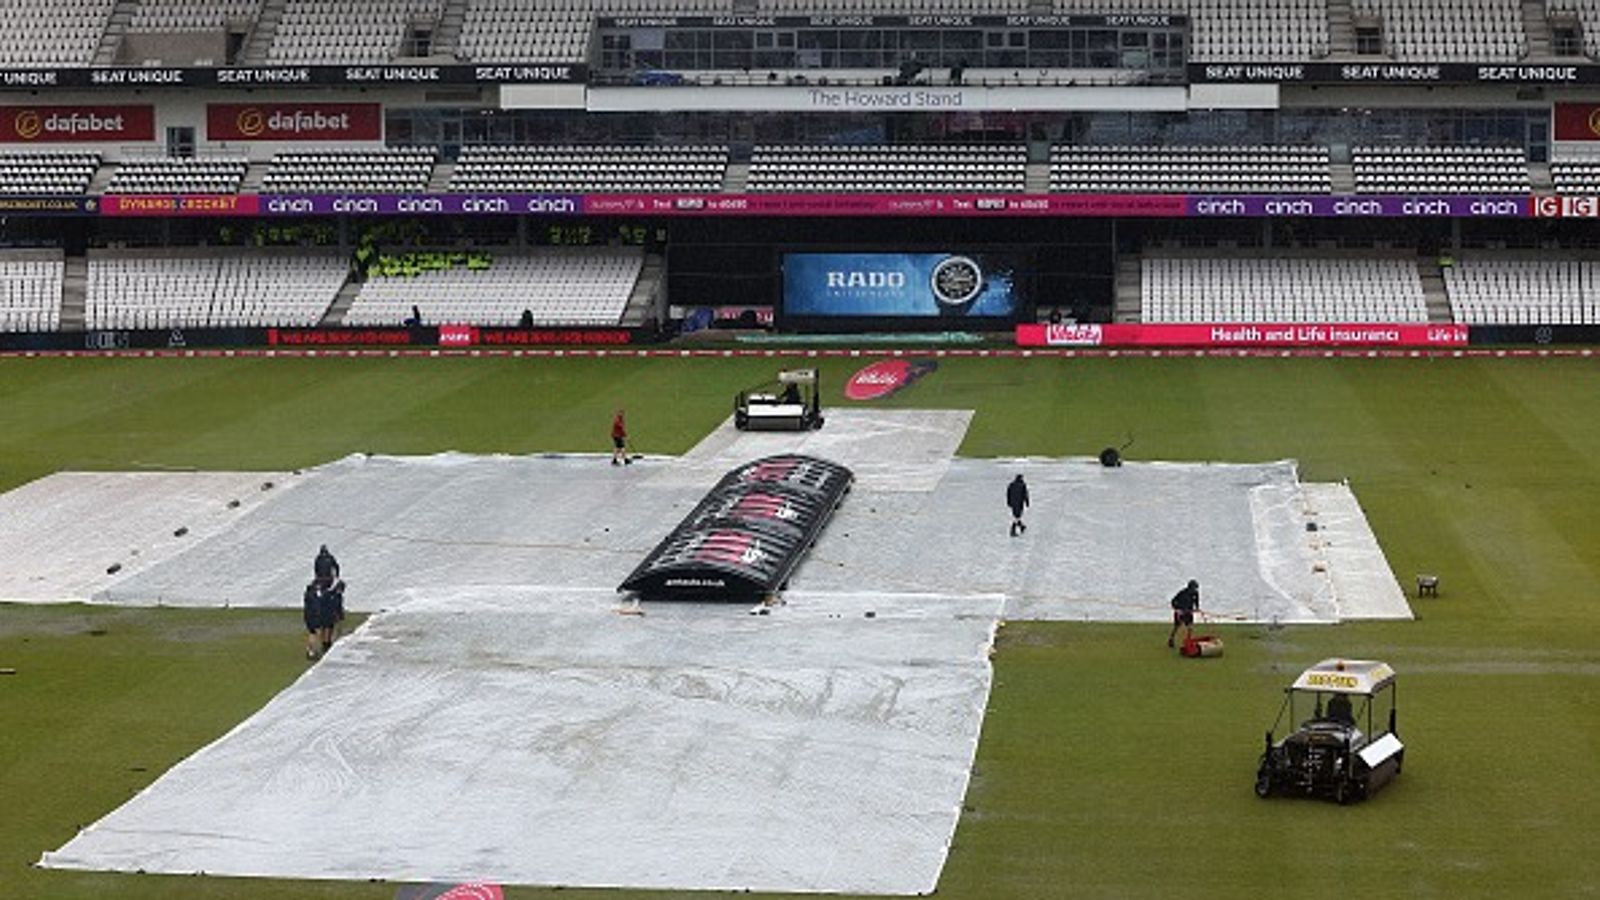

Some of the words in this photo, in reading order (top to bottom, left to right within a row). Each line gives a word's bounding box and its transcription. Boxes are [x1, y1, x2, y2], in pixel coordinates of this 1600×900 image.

[4, 72, 57, 85] UNIQUE
[91, 70, 125, 82] SEAT
[128, 70, 183, 82] UNIQUE
[217, 70, 252, 82] SEAT
[254, 70, 310, 82] UNIQUE
[346, 68, 381, 80] SEAT
[384, 68, 439, 80] UNIQUE
[476, 67, 511, 79] SEAT
[514, 67, 570, 79] UNIQUE
[1205, 66, 1242, 79] SEAT
[1246, 66, 1304, 79] UNIQUE
[1341, 66, 1378, 79] SEAT
[1382, 66, 1440, 79] UNIQUE
[1478, 67, 1516, 80] SEAT
[1519, 67, 1576, 80] UNIQUE
[808, 90, 840, 106] The
[845, 90, 911, 106] Howard
[915, 90, 963, 106] Stand
[44, 113, 124, 134] dafabet
[268, 110, 349, 133] dafabet
[268, 196, 313, 212] cinch
[333, 196, 378, 212] cinch
[397, 196, 442, 212] cinch
[462, 196, 508, 212] cinch
[528, 196, 574, 212] cinch
[1198, 197, 1245, 215] cinch
[1265, 197, 1313, 215] cinch
[1333, 197, 1382, 215] cinch
[1402, 197, 1451, 215] cinch
[1470, 197, 1518, 215] cinch
[1535, 197, 1558, 217] IG
[827, 271, 905, 287] RADO
[1212, 326, 1261, 341] Health
[1265, 326, 1294, 341] and
[1298, 326, 1326, 341] Life
